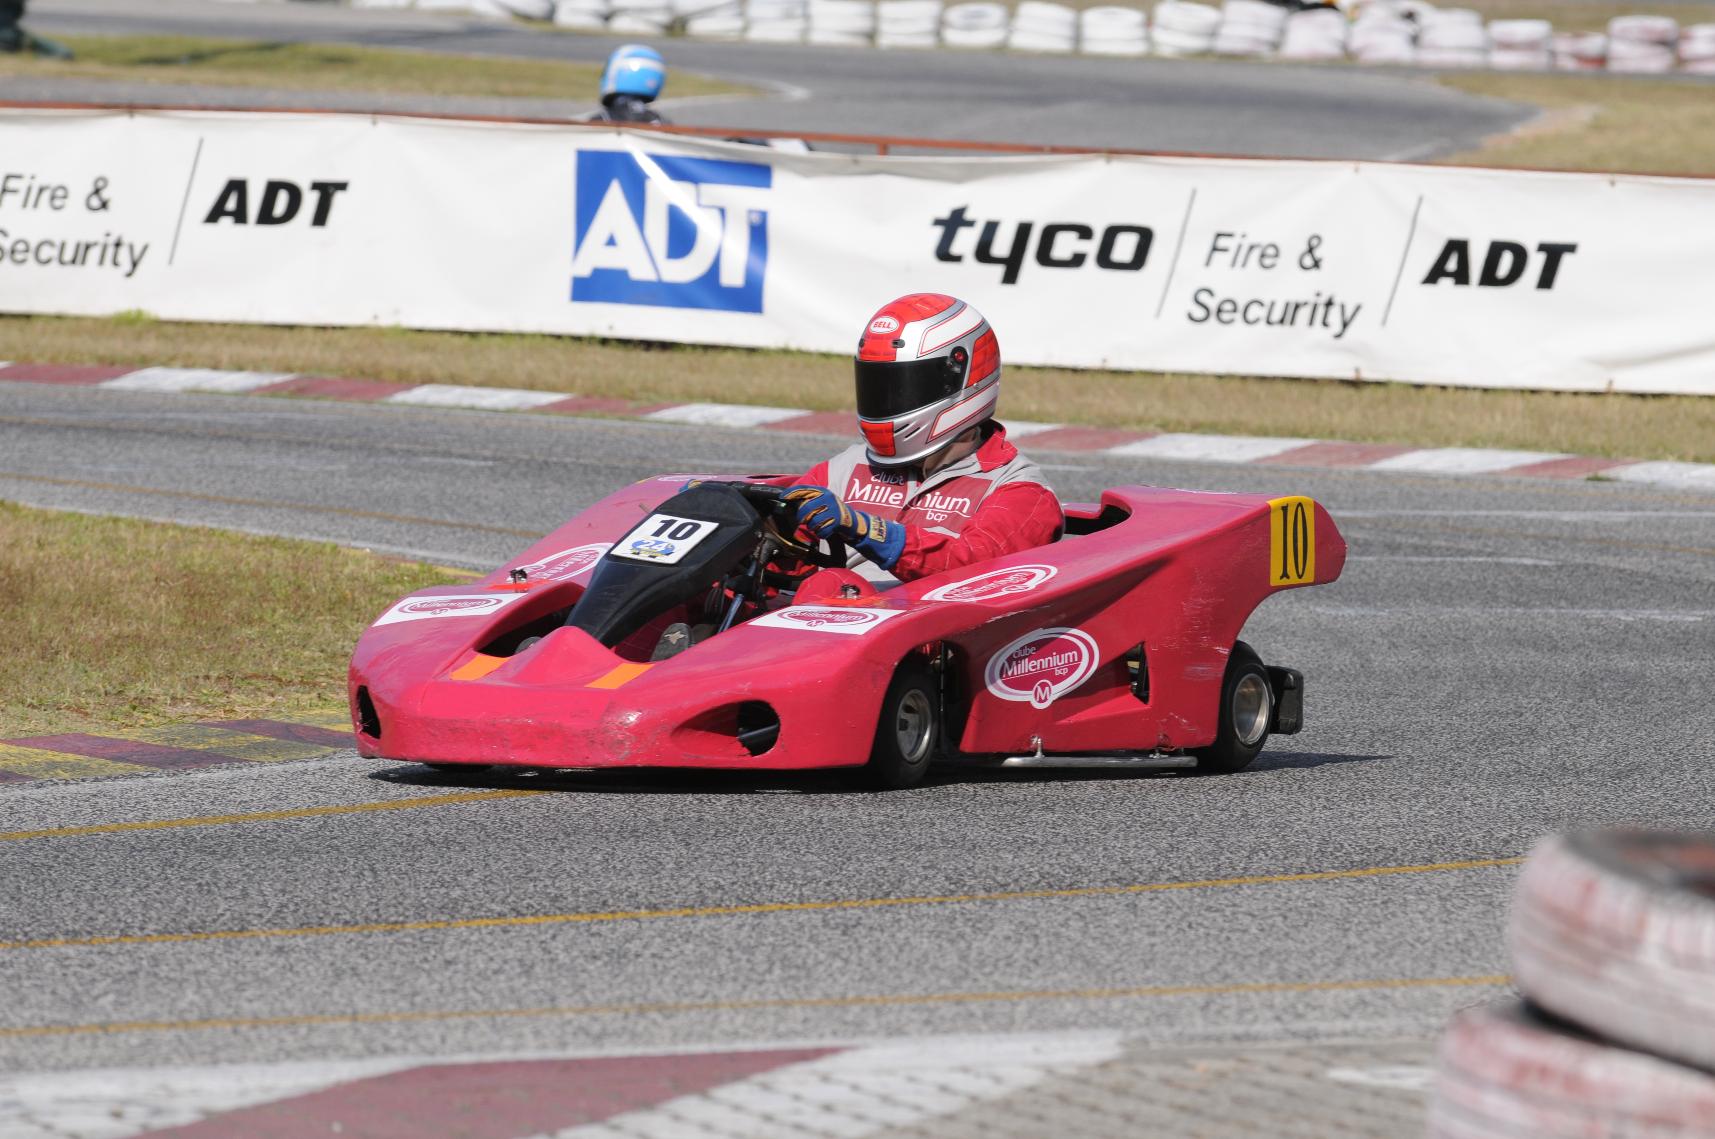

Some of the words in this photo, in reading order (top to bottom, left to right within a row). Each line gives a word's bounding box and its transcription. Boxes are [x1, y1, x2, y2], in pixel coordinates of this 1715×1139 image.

[0, 173, 69, 210] Fire
[85, 176, 110, 211] &
[203, 178, 349, 227] ADT
[573, 178, 771, 288] ADT
[932, 204, 1154, 285] tyco
[1205, 232, 1281, 269] Fire
[1299, 234, 1323, 271] &
[1421, 238, 1577, 290] ADT
[873, 321, 893, 329] BELL
[1187, 288, 1361, 339] Security
[651, 519, 702, 541] 10
[926, 509, 948, 523] bcp
[1280, 502, 1308, 580] 10
[1003, 650, 1078, 678] Millennium
[1013, 645, 1036, 659] clube
[1055, 667, 1069, 676] bcp
